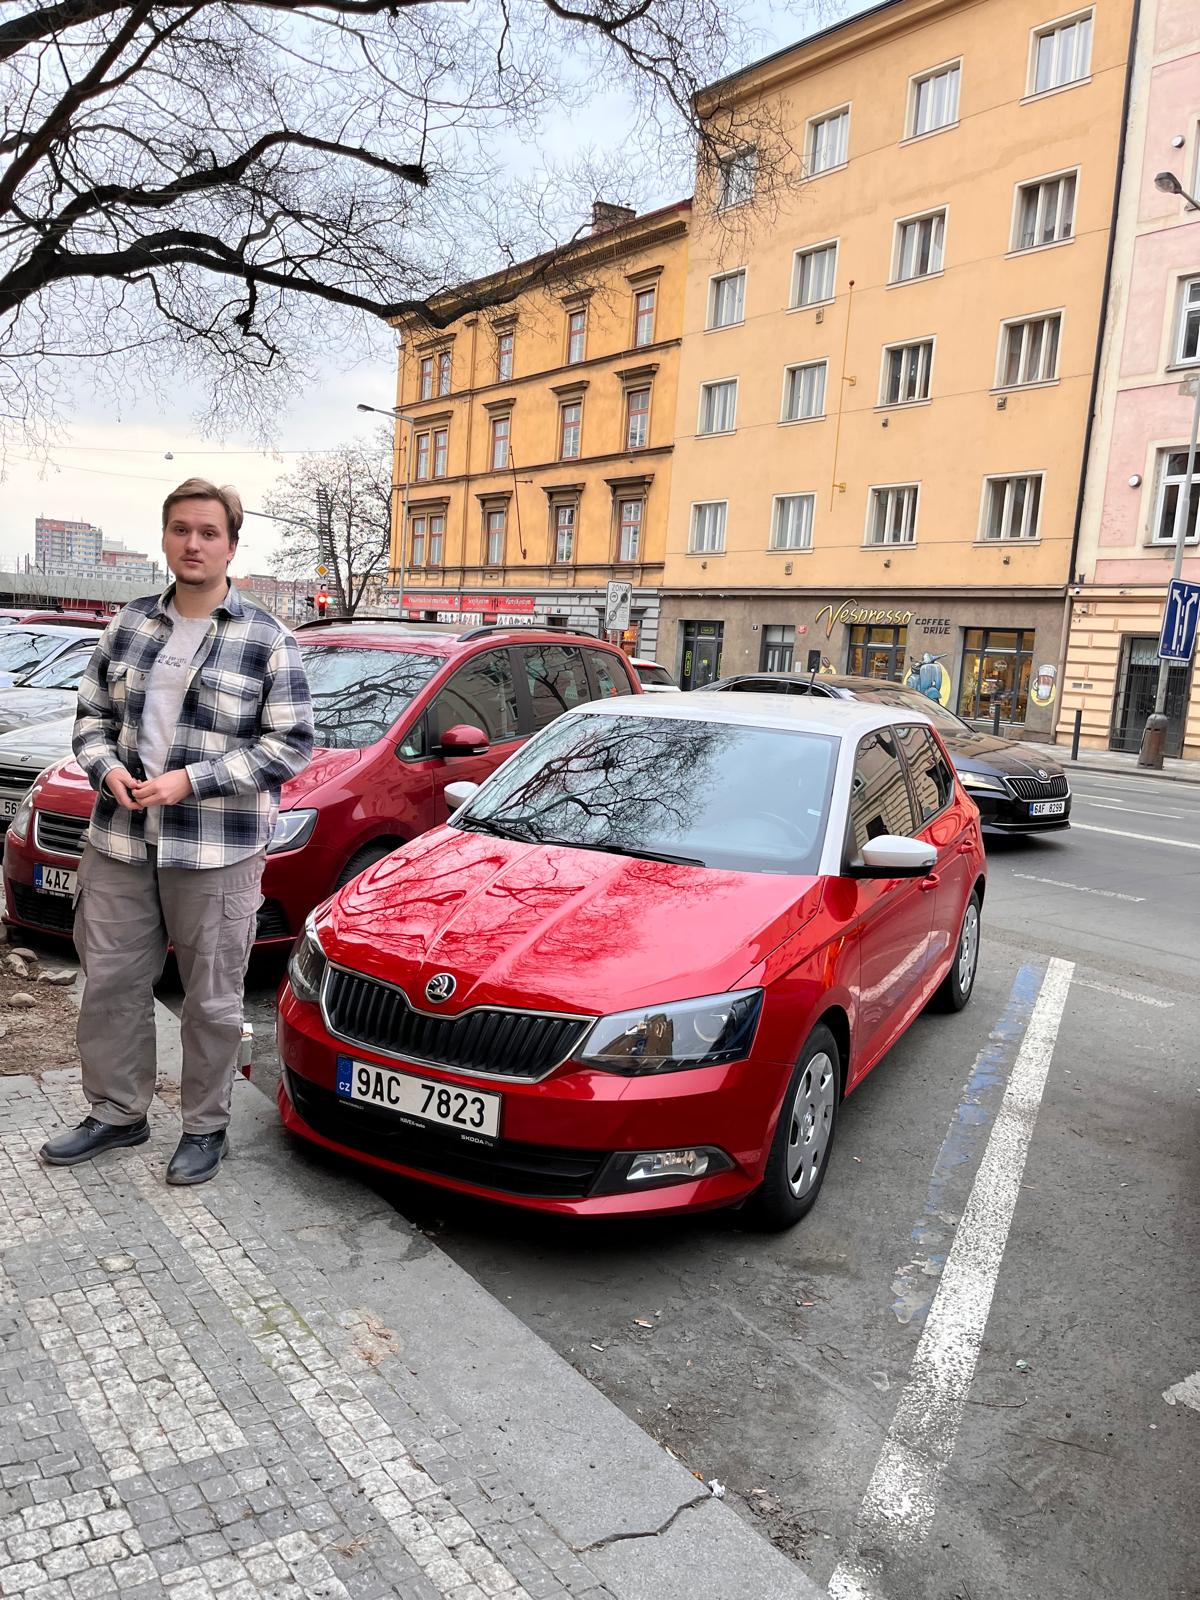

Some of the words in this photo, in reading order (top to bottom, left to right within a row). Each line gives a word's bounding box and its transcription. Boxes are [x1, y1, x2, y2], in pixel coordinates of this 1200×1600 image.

[815, 598, 915, 638] Vespresso
[915, 618, 951, 626] COFFEE
[923, 626, 951, 635] DRIVE
[4, 801, 19, 815] 56
[1035, 804, 1046, 814] 6AF
[45, 869, 70, 890] 4AZ
[339, 1081, 350, 1092] CZ
[357, 1067, 401, 1105] 9AC
[420, 1083, 485, 1128] 7823
